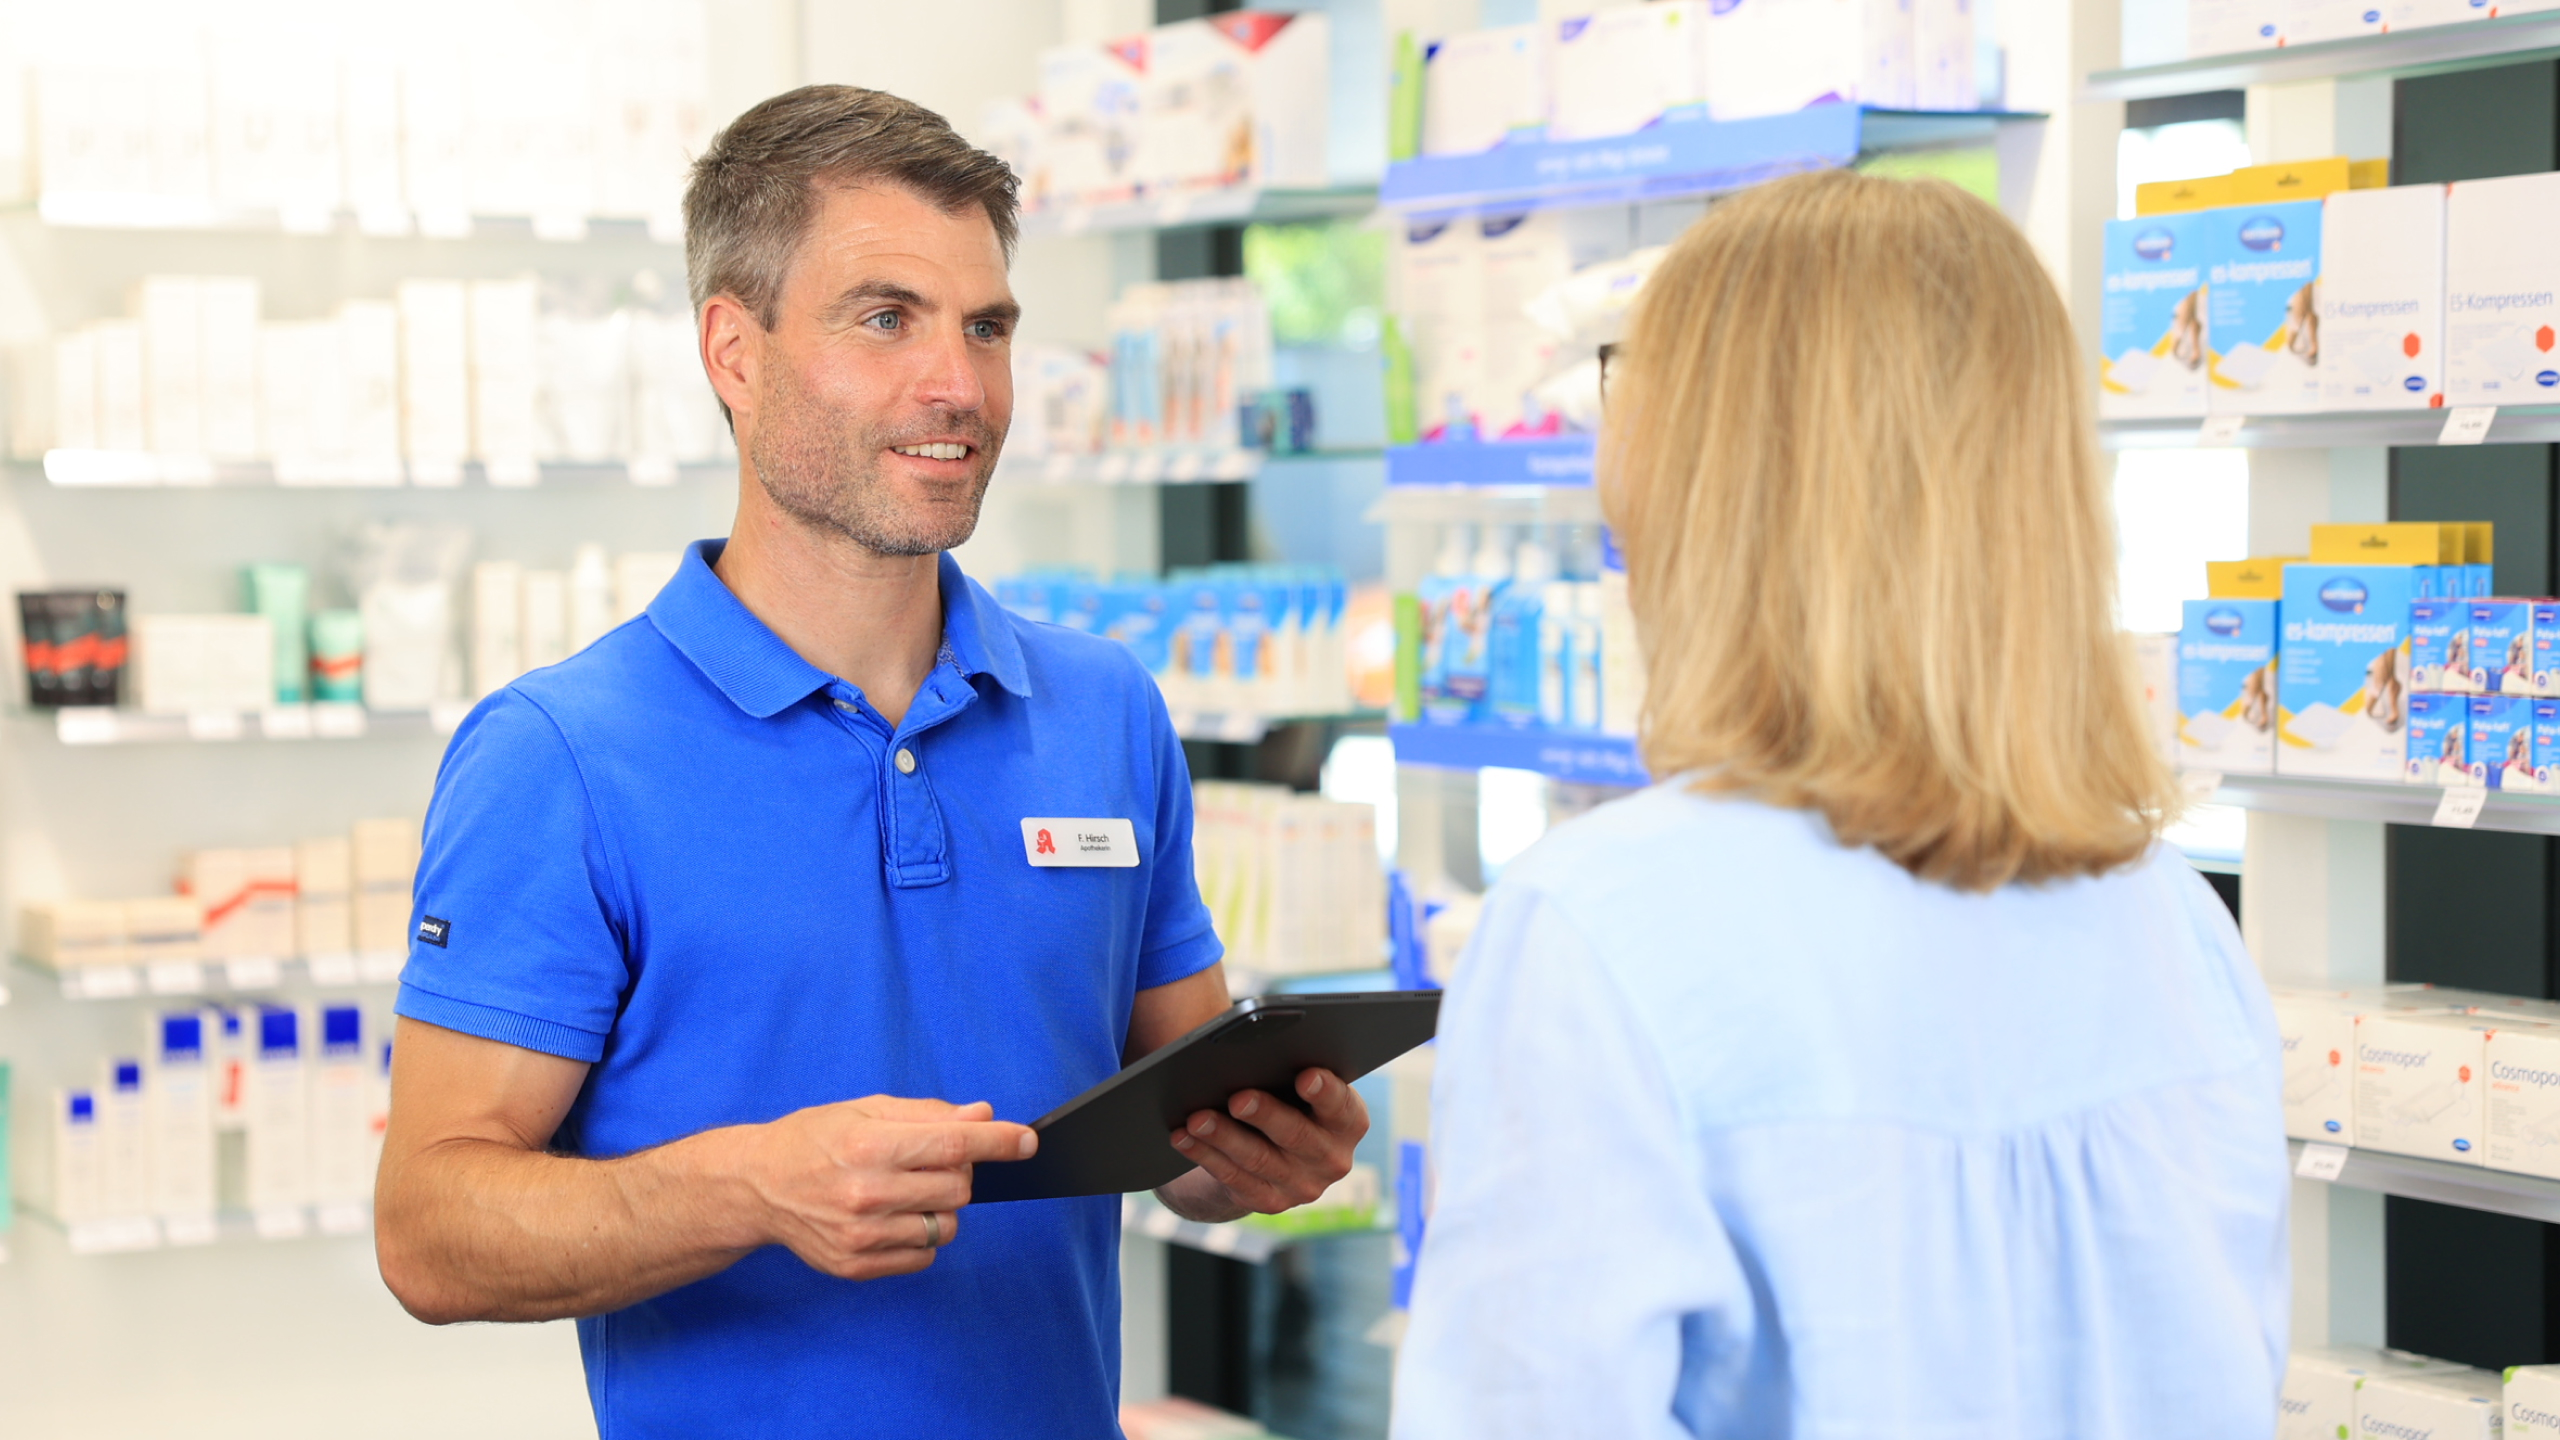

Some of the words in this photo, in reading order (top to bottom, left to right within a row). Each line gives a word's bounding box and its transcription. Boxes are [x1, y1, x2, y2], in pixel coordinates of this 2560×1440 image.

[2324, 299, 2419, 320] ES-Kompressen
[2450, 290, 2553, 312] ES-Kompressen
[1077, 833, 1085, 843] F.
[1086, 833, 1109, 843] Hirsch
[2360, 1044, 2427, 1070] Cosmopor
[2492, 1061, 2560, 1089] Cosmopo
[2512, 1402, 2560, 1435] Cosmo
